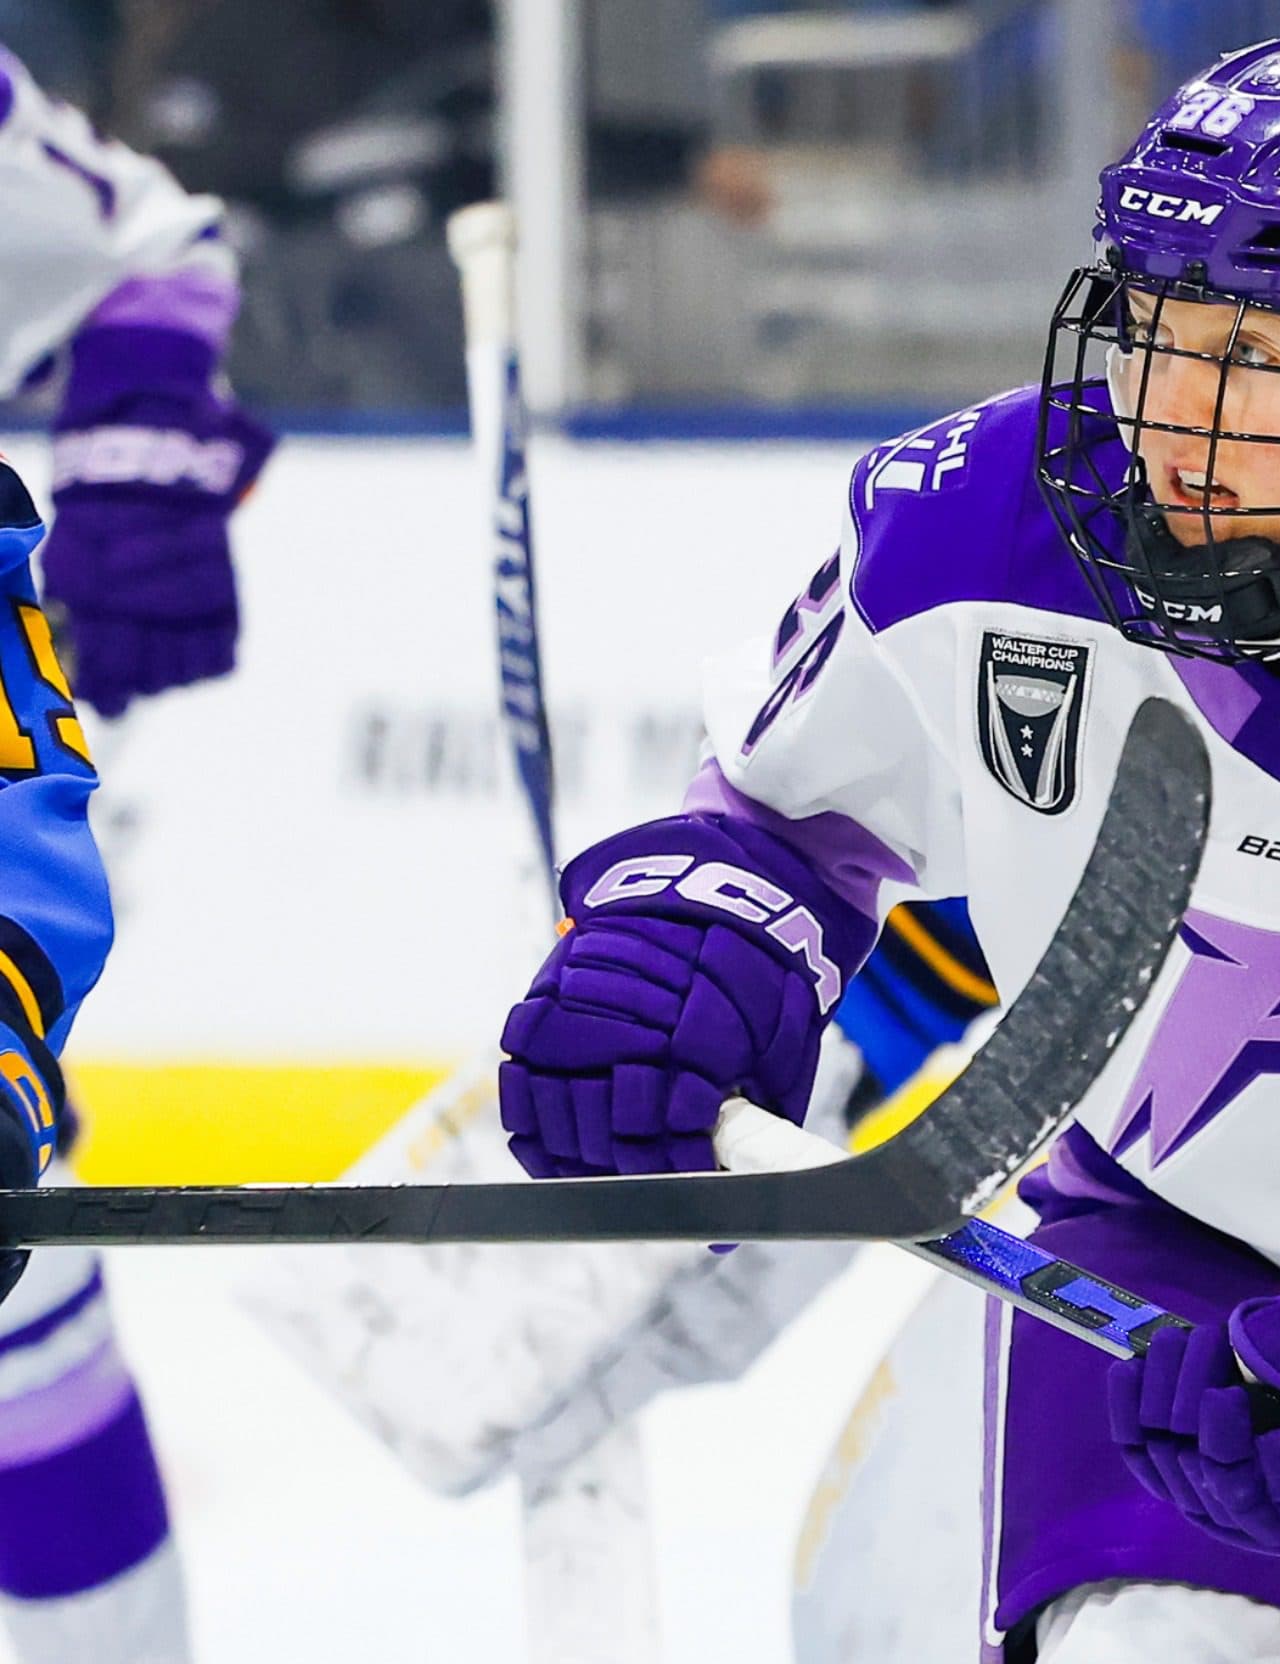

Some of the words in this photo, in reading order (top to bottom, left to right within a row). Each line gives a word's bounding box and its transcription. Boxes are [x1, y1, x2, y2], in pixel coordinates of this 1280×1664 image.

[1119, 186, 1226, 225] CCM
[1133, 584, 1223, 623] CCM
[992, 636, 1047, 656] WALTER
[1048, 646, 1079, 660] CUP
[992, 650, 1076, 672] CHAMPIONS
[583, 854, 842, 1016] CCM
